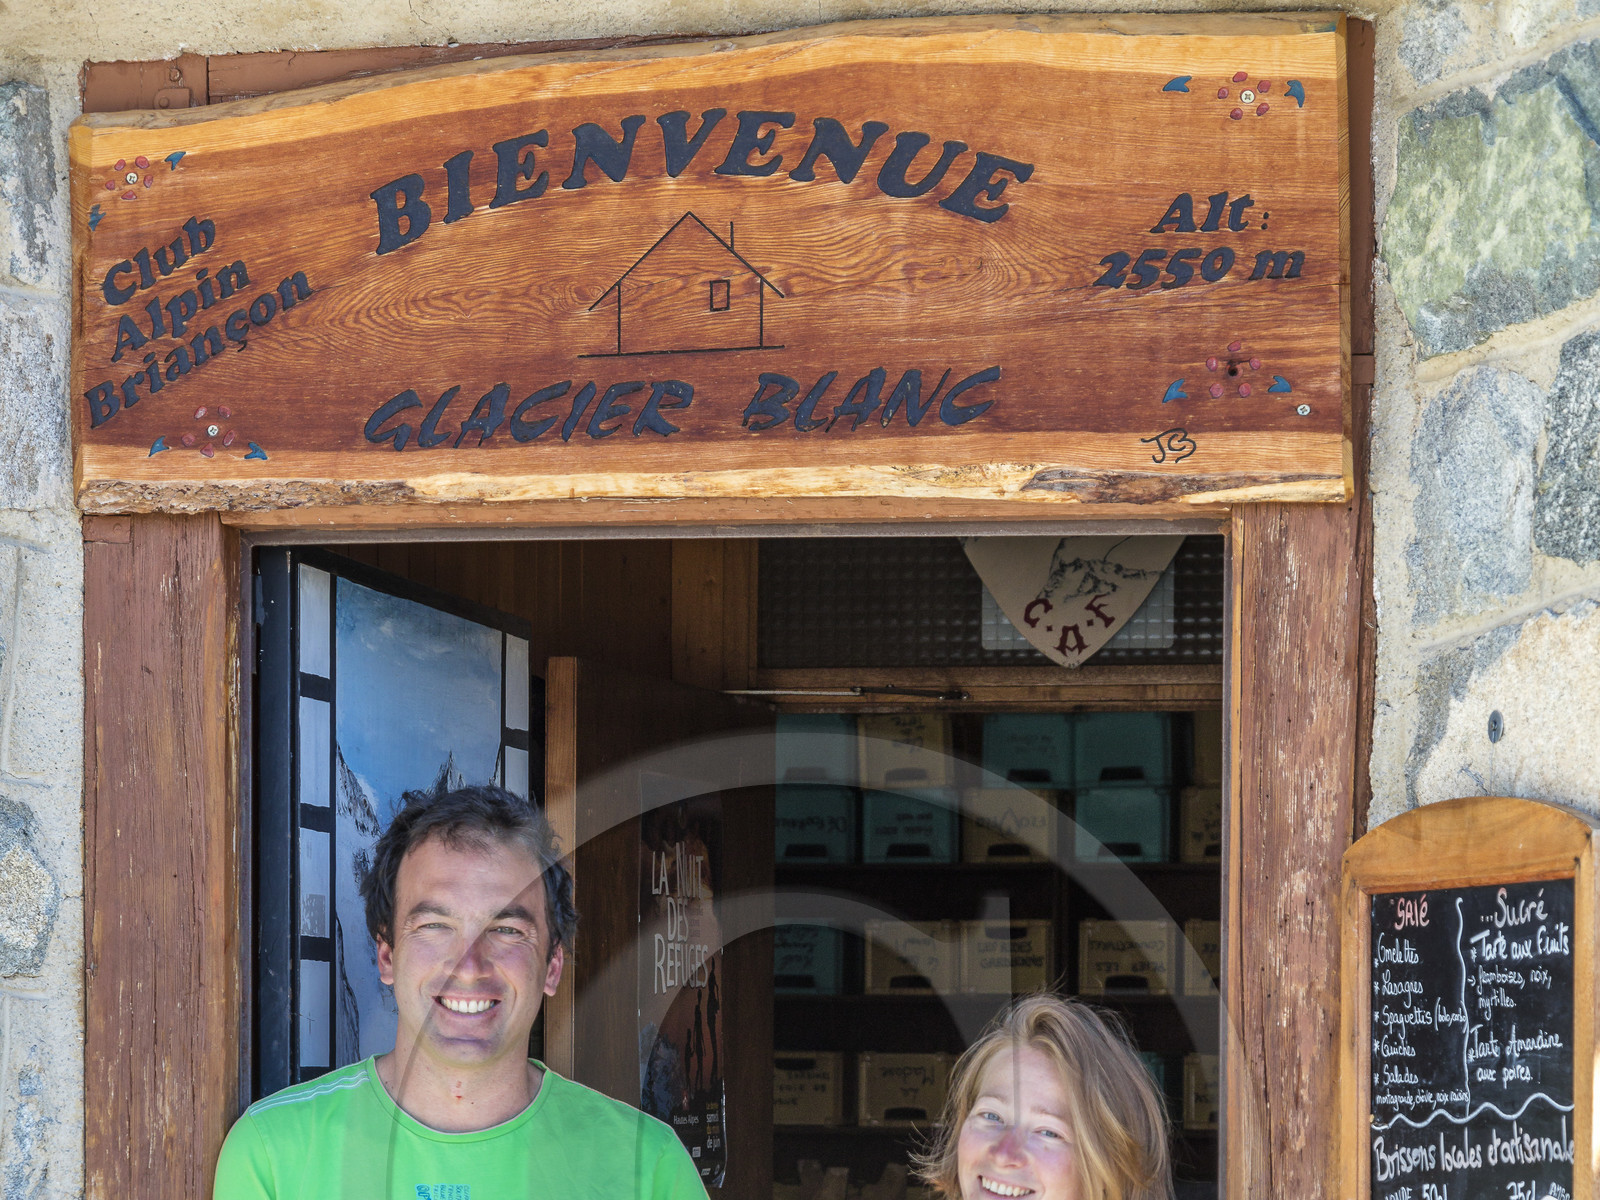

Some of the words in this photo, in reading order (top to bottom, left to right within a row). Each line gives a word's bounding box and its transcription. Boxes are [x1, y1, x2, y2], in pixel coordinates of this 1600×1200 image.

[370, 107, 1034, 255] BIENVENUE
[1149, 191, 1270, 232] Alt:
[101, 215, 216, 306] Club
[1093, 246, 1235, 290] 2550
[1249, 249, 1305, 279] m
[111, 258, 249, 363] Alpin
[83, 268, 314, 429] Briançon
[364, 379, 694, 451] GLACIER
[742, 365, 1001, 433] BLANC
[652, 850, 669, 896] LA
[675, 841, 704, 898] NUIT
[667, 896, 689, 942] DES
[654, 932, 709, 995] REFUGES
[1383, 1063, 1419, 1085] Salades
[1373, 1136, 1436, 1182] Boissons
[1439, 1127, 1482, 1172] locales
